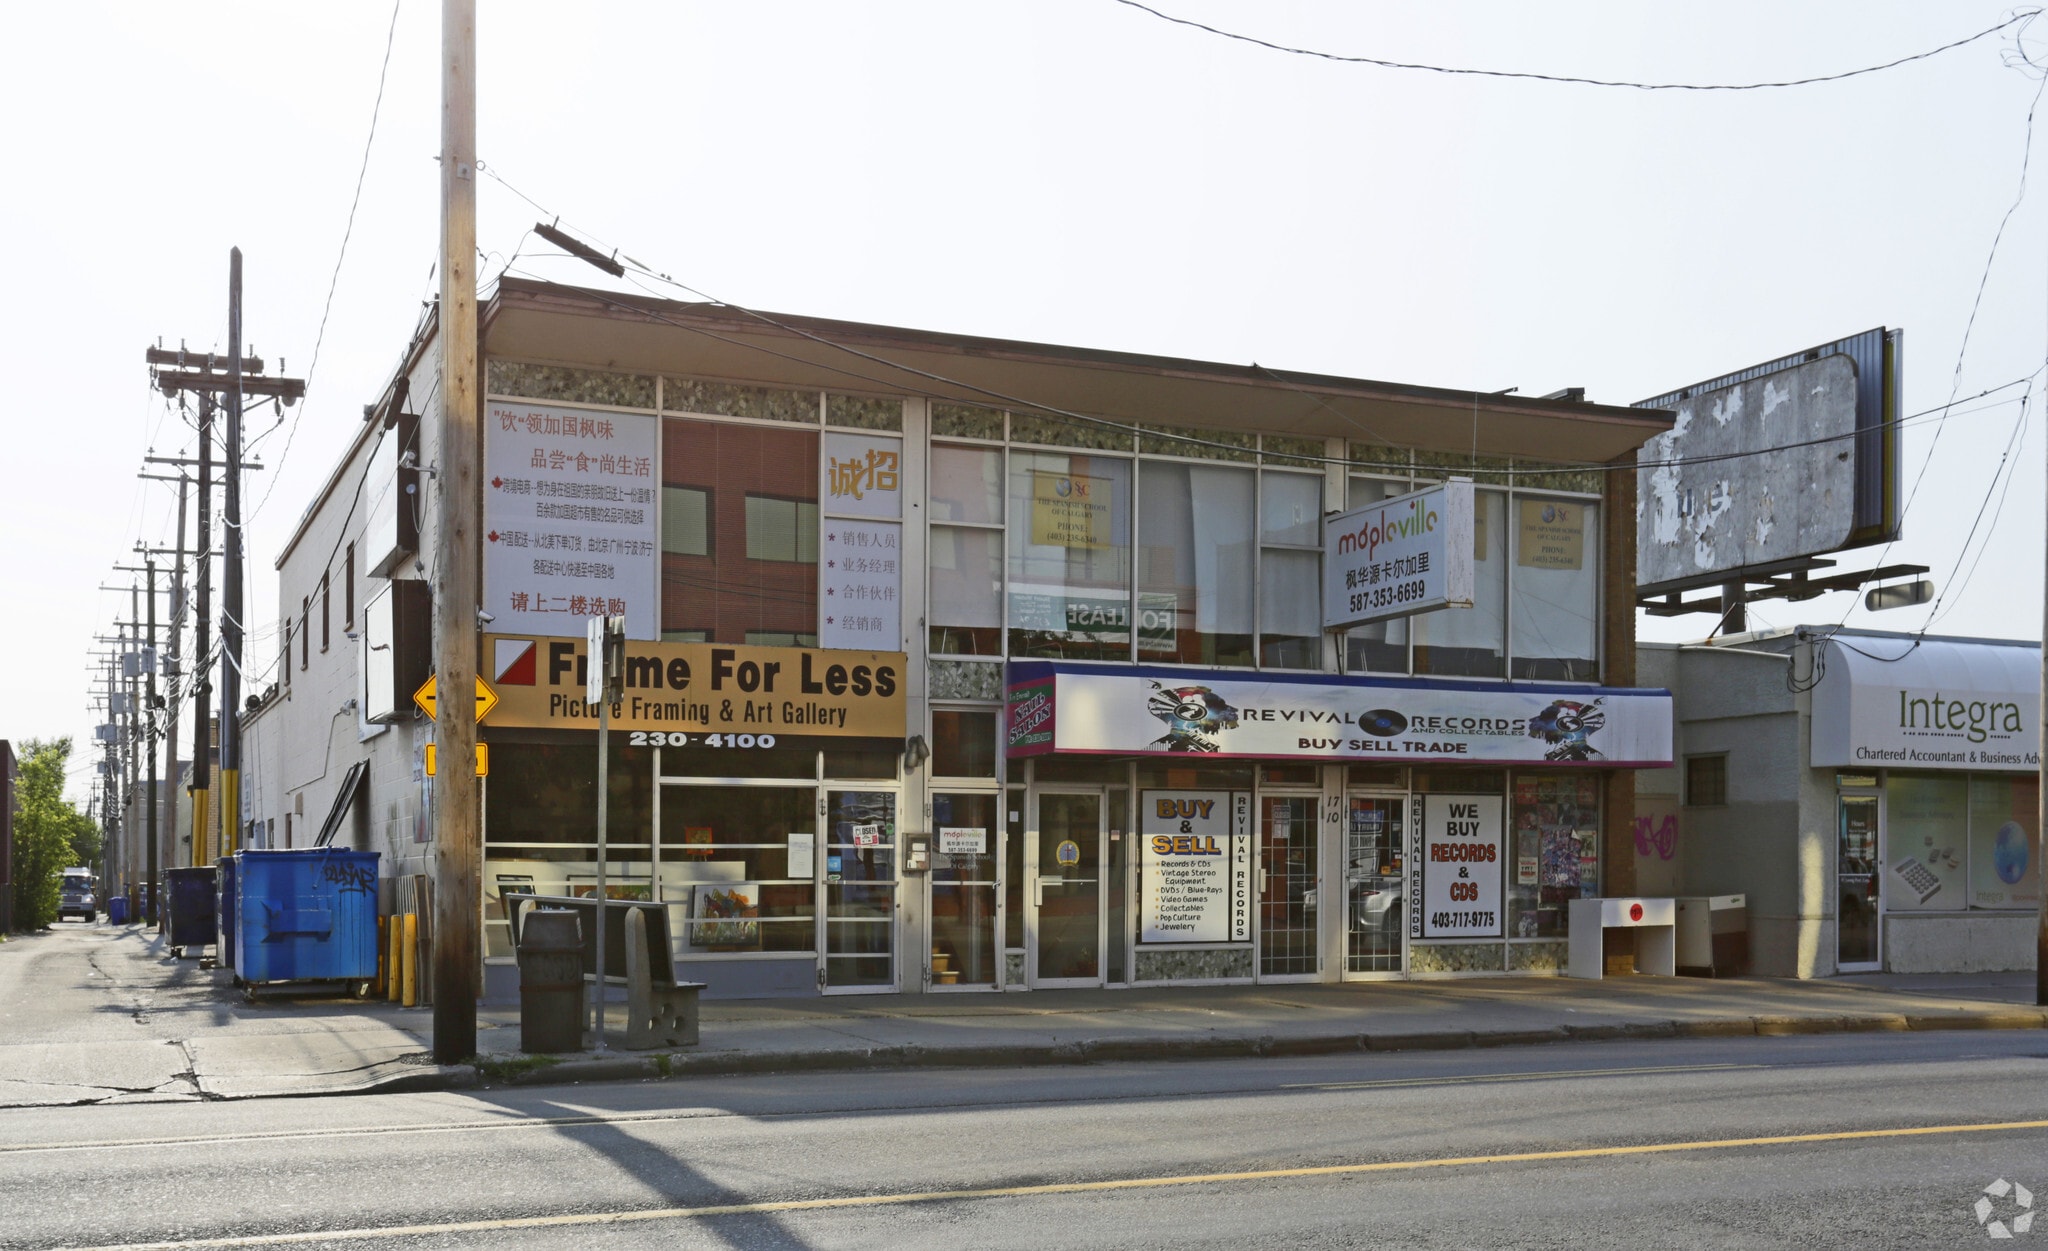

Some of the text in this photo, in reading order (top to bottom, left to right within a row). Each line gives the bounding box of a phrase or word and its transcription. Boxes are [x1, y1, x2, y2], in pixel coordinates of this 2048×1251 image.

[828, 449, 898, 500] 诚招
[842, 531, 896, 549] 销售人员
[842, 557, 896, 575] 业务经理
[1346, 552, 1430, 590] 枫华源卡尔加里
[842, 583, 896, 602] 合作伙伴
[1350, 580, 1425, 613] 587-353-6699
[510, 591, 626, 617] 请上二楼选购
[842, 615, 883, 632] 经销商
[549, 641, 896, 697] Frme For Less
[550, 693, 847, 728] Pictue Framing & Art Gallery
[1243, 708, 1525, 731] REVIVAL RECORDS
[1900, 690, 2023, 743] Integra
[1009, 703, 1051, 745] SALON
[1439, 728, 1525, 737] COLLECTABLES
[1299, 738, 1468, 754] BUY SELL TRADE
[1856, 747, 1906, 760] Chartered
[1909, 749, 1966, 763] Accountant
[1969, 752, 1977, 763] &
[1980, 751, 2021, 764] Business
[1156, 798, 1215, 820] BUY
[1326, 795, 1340, 807] 17
[1326, 812, 1339, 824] 10
[1449, 803, 1479, 819] WE
[1180, 820, 1192, 833] &
[1447, 821, 1480, 837] BUY
[1151, 835, 1222, 856] SELL
[1431, 843, 1497, 863] RECORDS
[1161, 869, 1189, 877] Vintage
[1236, 796, 1246, 936] REVIVAL RECORDS
[1412, 799, 1421, 933] REVIVAL RECORDS
[1458, 866, 1469, 879] &
[1165, 878, 1206, 886] Equipment
[1187, 886, 1223, 894] Blue-Rays
[1450, 882, 1478, 902] CDS
[1160, 914, 1172, 922] Pop
[1431, 911, 1495, 929] 403-717-9775
[1160, 923, 1196, 932] Jewelery
